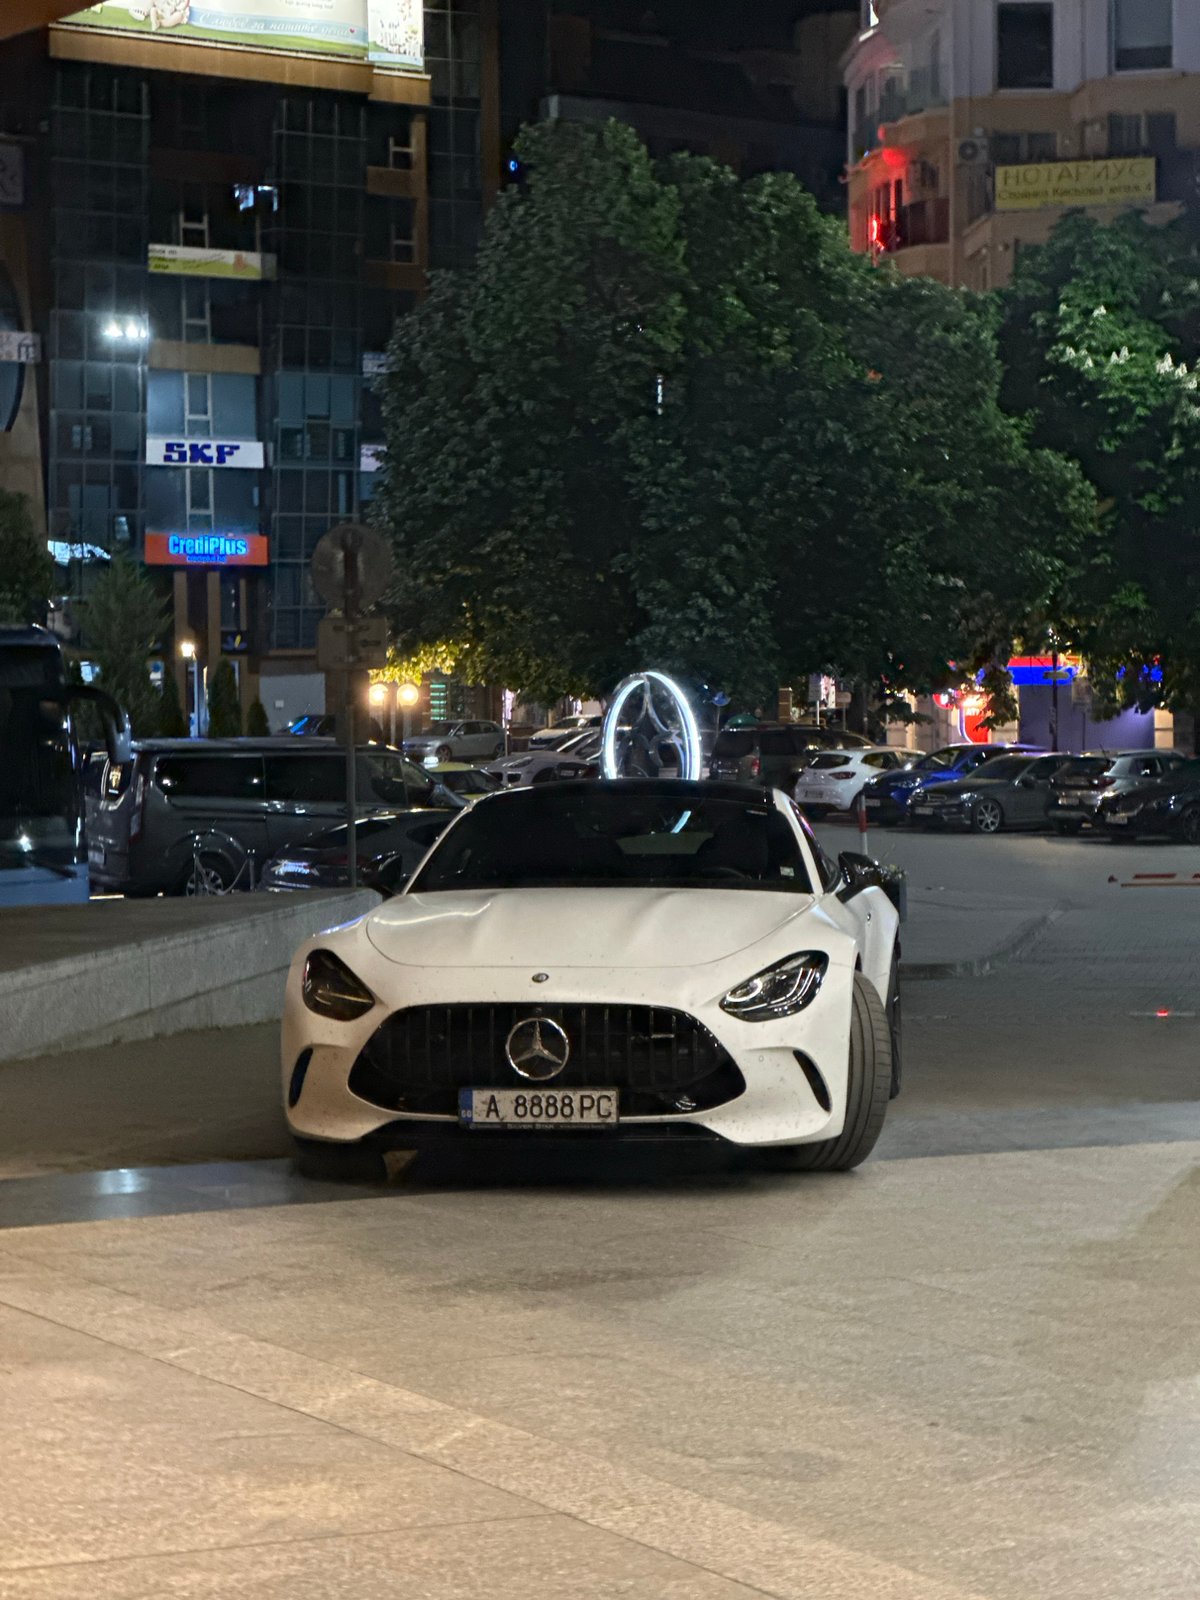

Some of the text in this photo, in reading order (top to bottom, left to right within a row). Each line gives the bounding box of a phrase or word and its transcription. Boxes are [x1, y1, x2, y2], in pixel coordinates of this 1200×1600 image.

[1003, 162, 1146, 186] НОТАРИУС
[163, 443, 240, 464] SKF
[168, 535, 248, 555] CrediPlus
[486, 1094, 612, 1118] A 8888 PC
